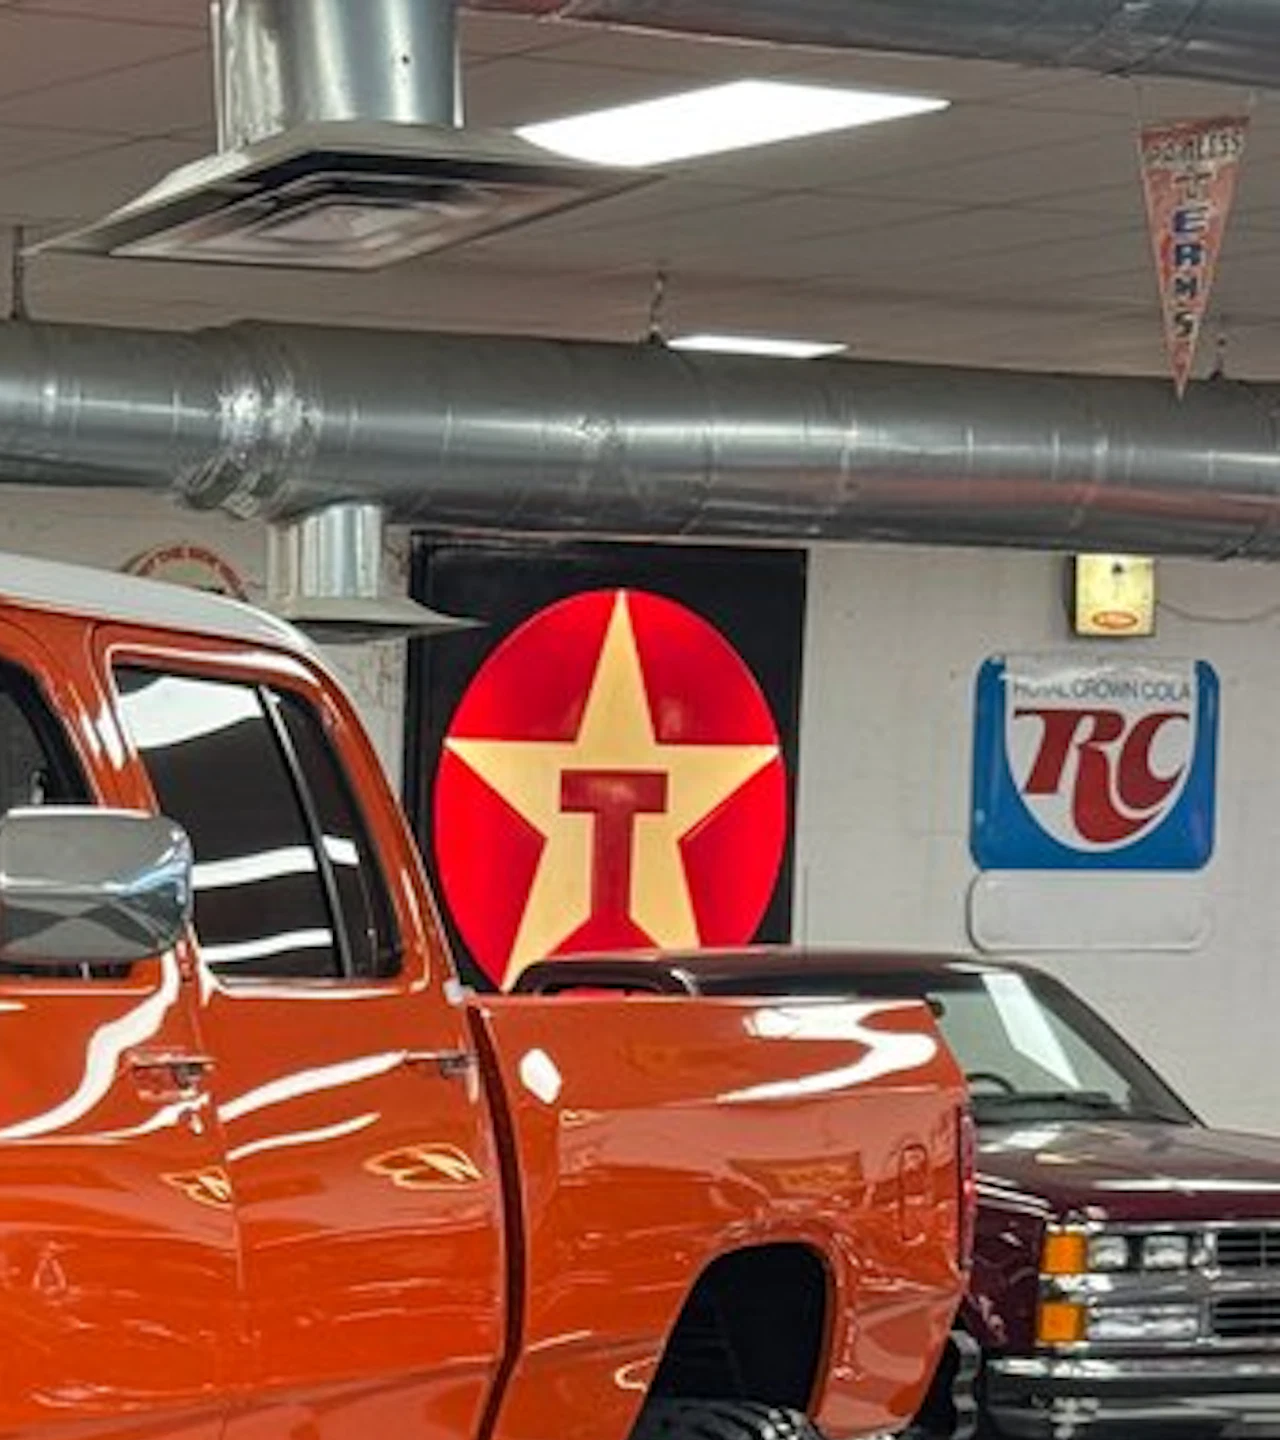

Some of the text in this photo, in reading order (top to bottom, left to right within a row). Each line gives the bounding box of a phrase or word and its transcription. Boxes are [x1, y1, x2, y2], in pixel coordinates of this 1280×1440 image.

[1070, 678, 1138, 699] CROWN
[1142, 681, 1190, 701] COLA
[1014, 709, 1190, 843] RC
[560, 770, 668, 922] T
